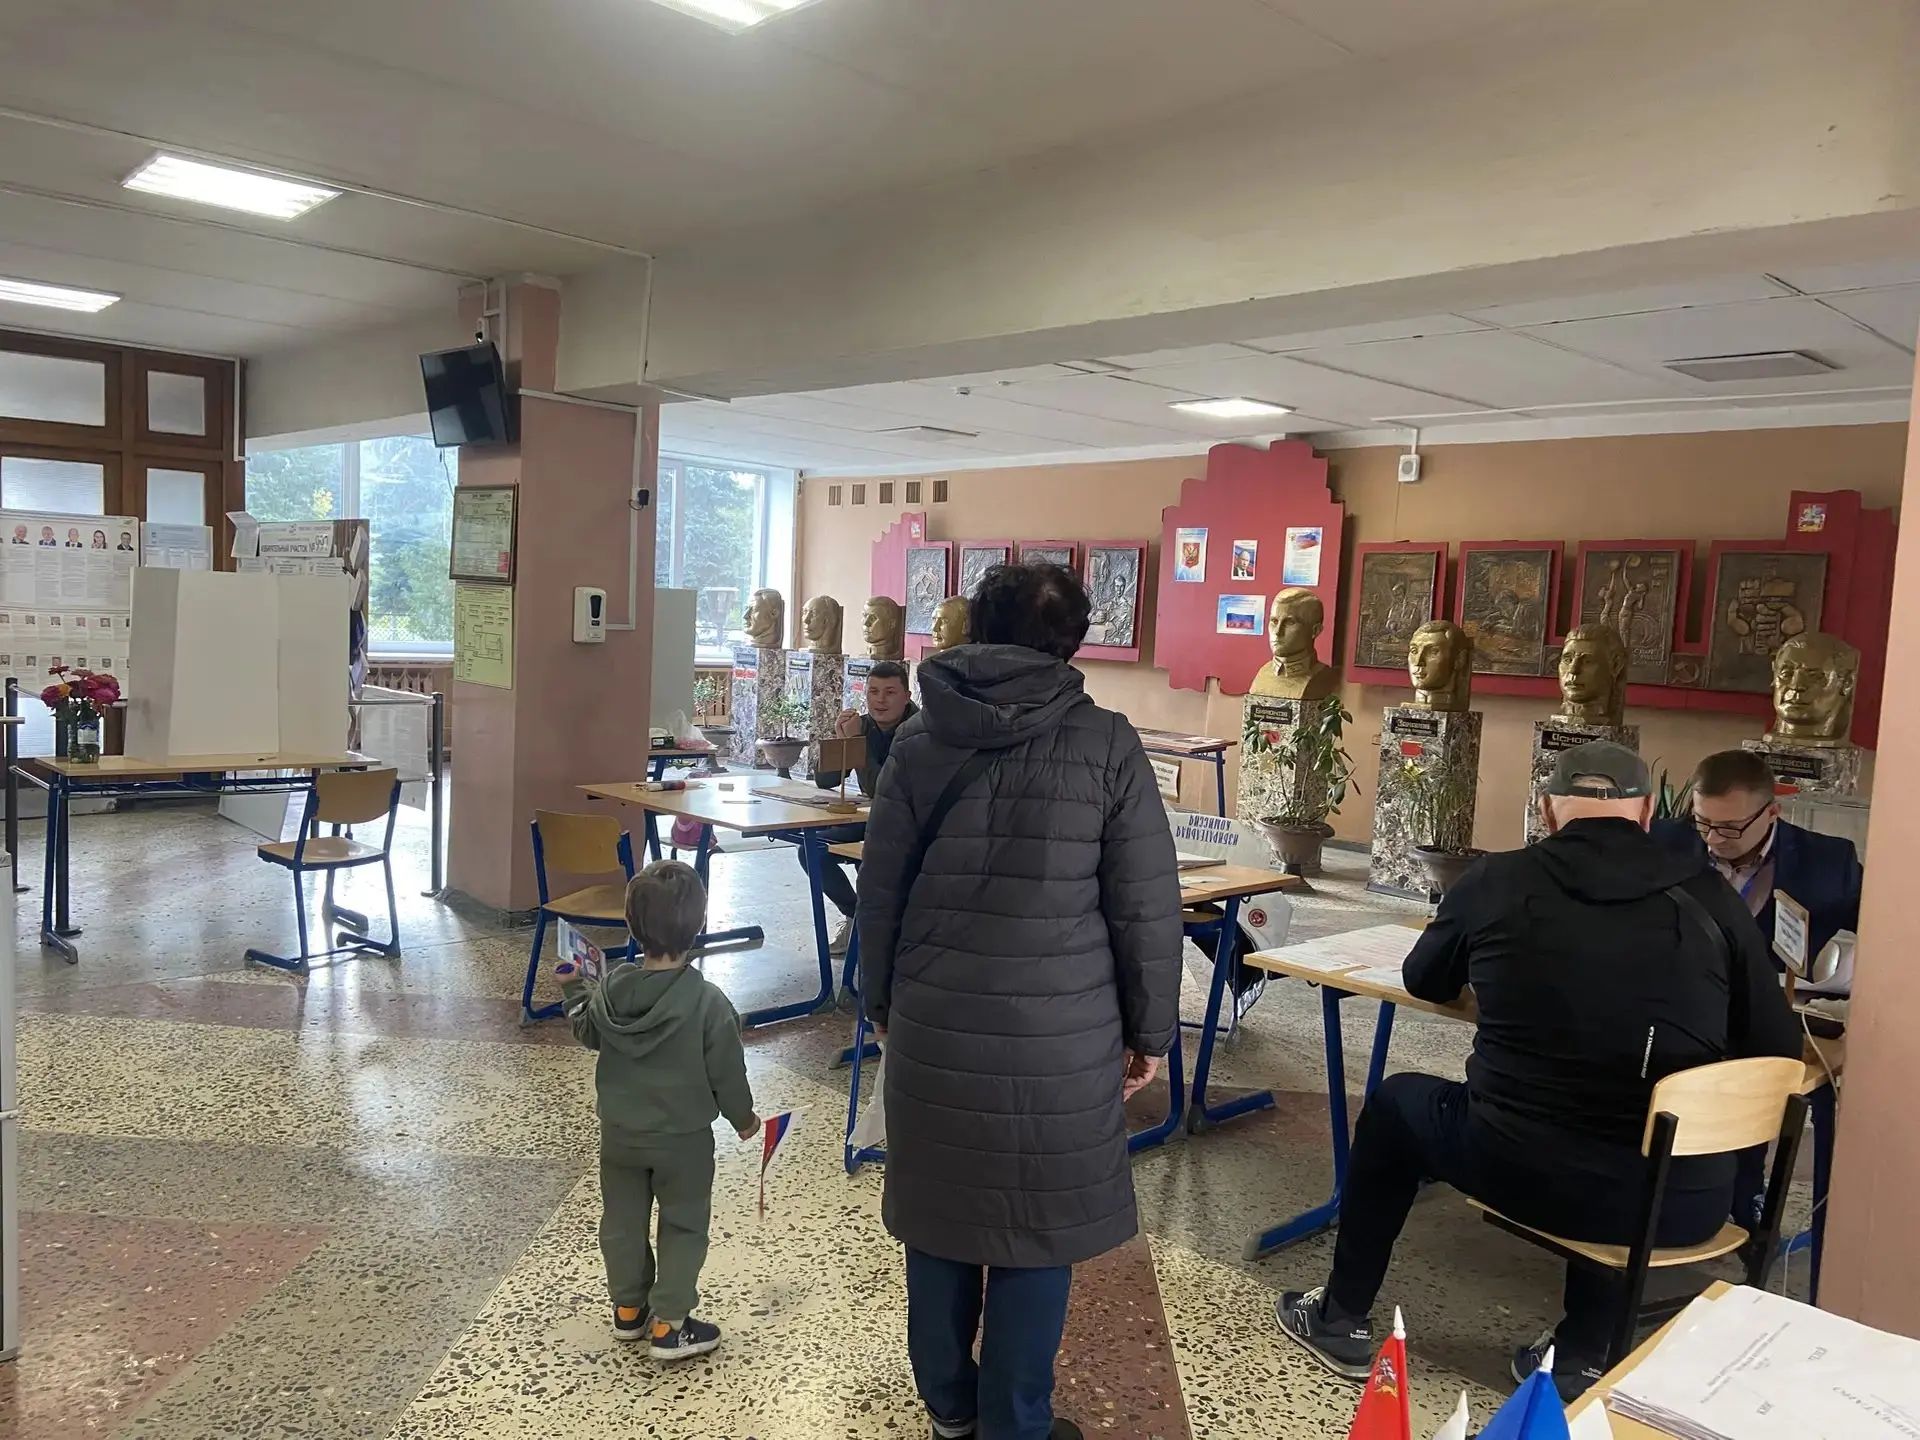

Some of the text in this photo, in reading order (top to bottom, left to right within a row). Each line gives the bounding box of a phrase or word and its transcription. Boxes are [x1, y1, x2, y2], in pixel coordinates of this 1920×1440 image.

[1188, 815, 1232, 831] КОМИССИЯ
[1176, 825, 1239, 846] ИЗБИРАТЕЛЬНАЯ
[1293, 1309, 1311, 1337] N
